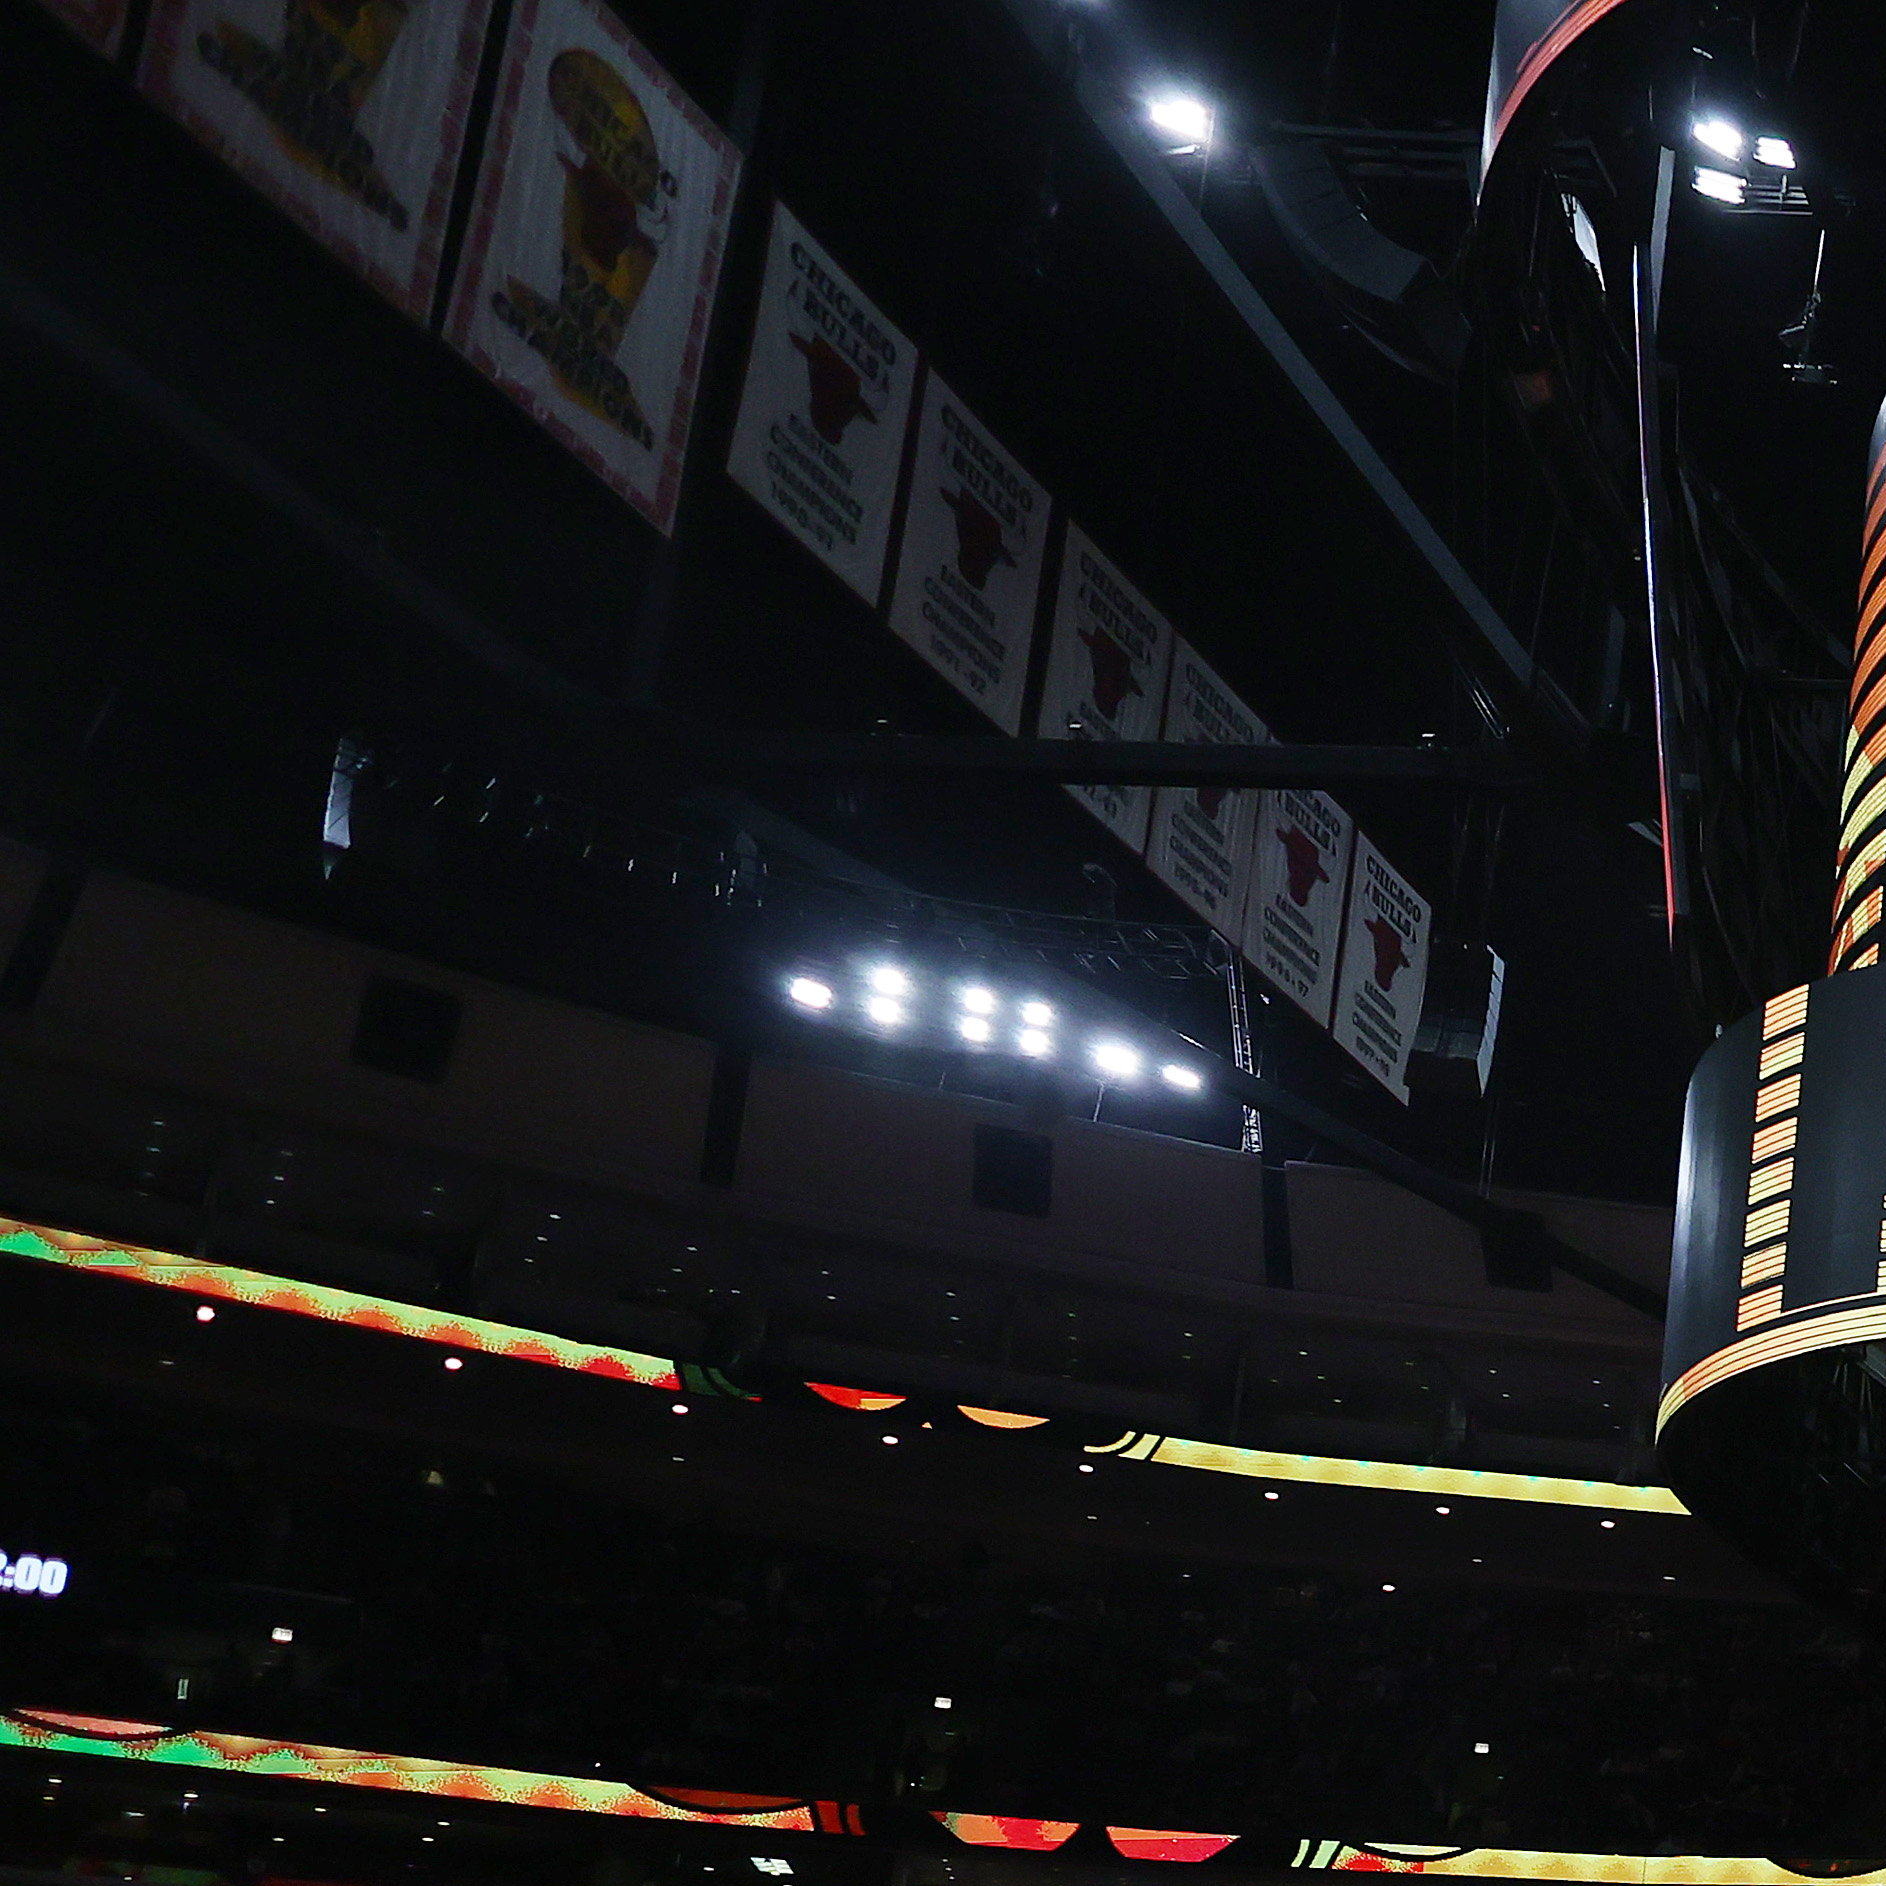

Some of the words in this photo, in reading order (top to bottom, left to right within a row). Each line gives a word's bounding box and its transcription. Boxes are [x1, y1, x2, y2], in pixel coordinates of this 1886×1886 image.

[791, 242, 896, 366] CHICAGO
[803, 287, 879, 380] BULLS
[940, 404, 1034, 512] CHICAGO
[952, 446, 1018, 526] BULLS
[1365, 854, 1422, 925] CHICAGO
[1370, 886, 1413, 939] BULLS
